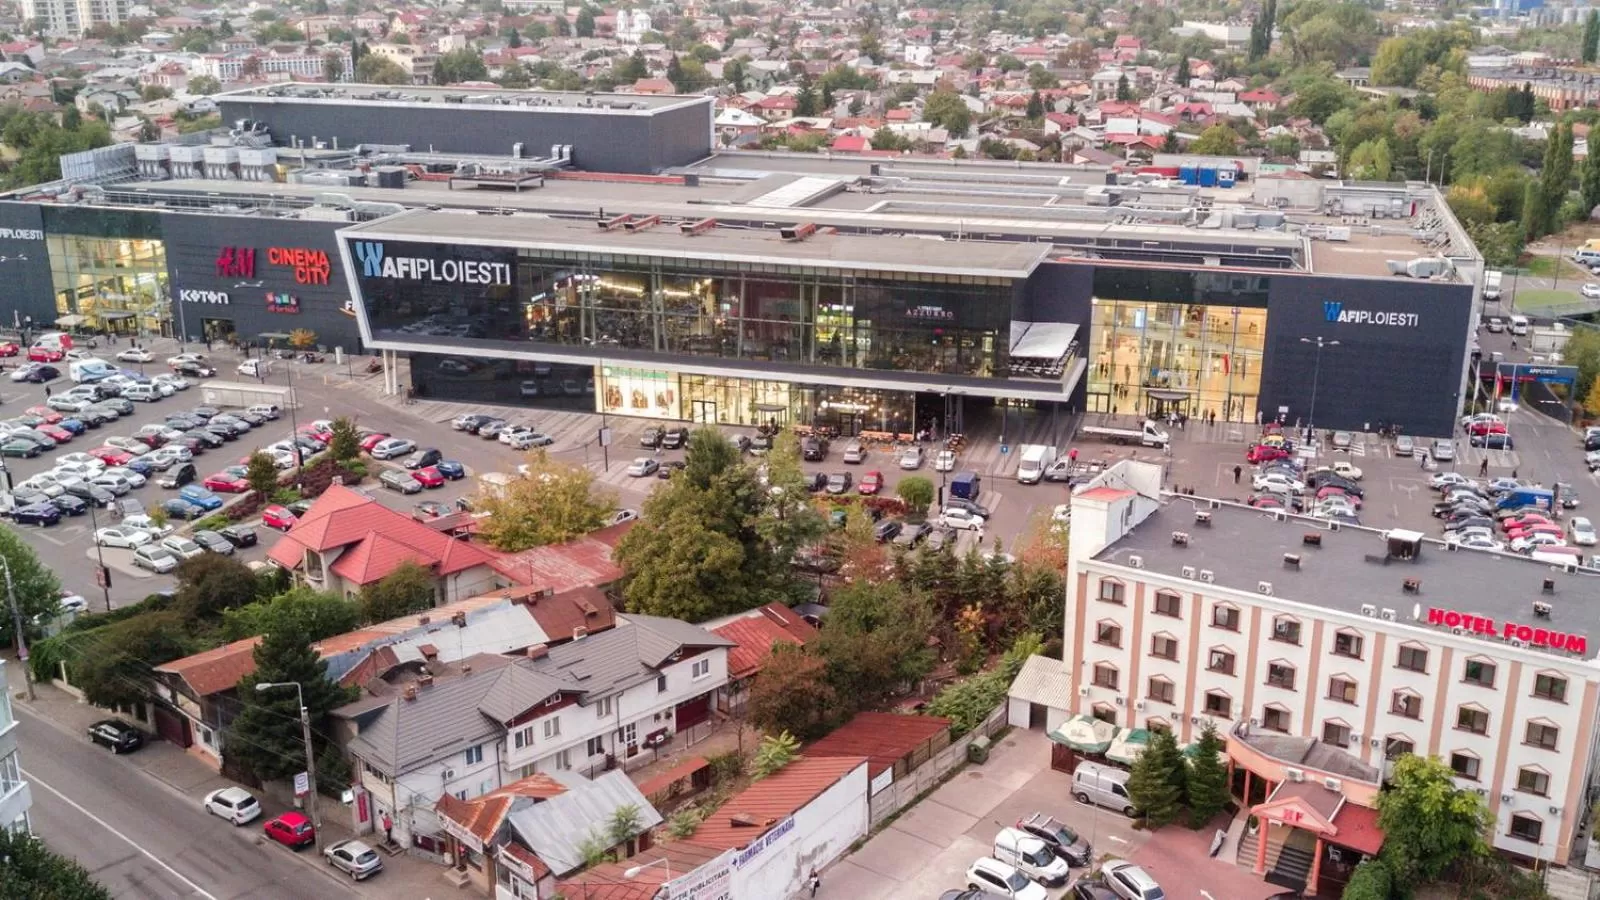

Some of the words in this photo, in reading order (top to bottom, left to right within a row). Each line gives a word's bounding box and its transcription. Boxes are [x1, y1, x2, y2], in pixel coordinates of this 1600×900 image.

[216, 246, 255, 279] H&M
[267, 247, 330, 267] CINEMA
[295, 266, 330, 286] CITY
[1428, 608, 1497, 635] HOTEL
[1503, 623, 1586, 654] FORUM
